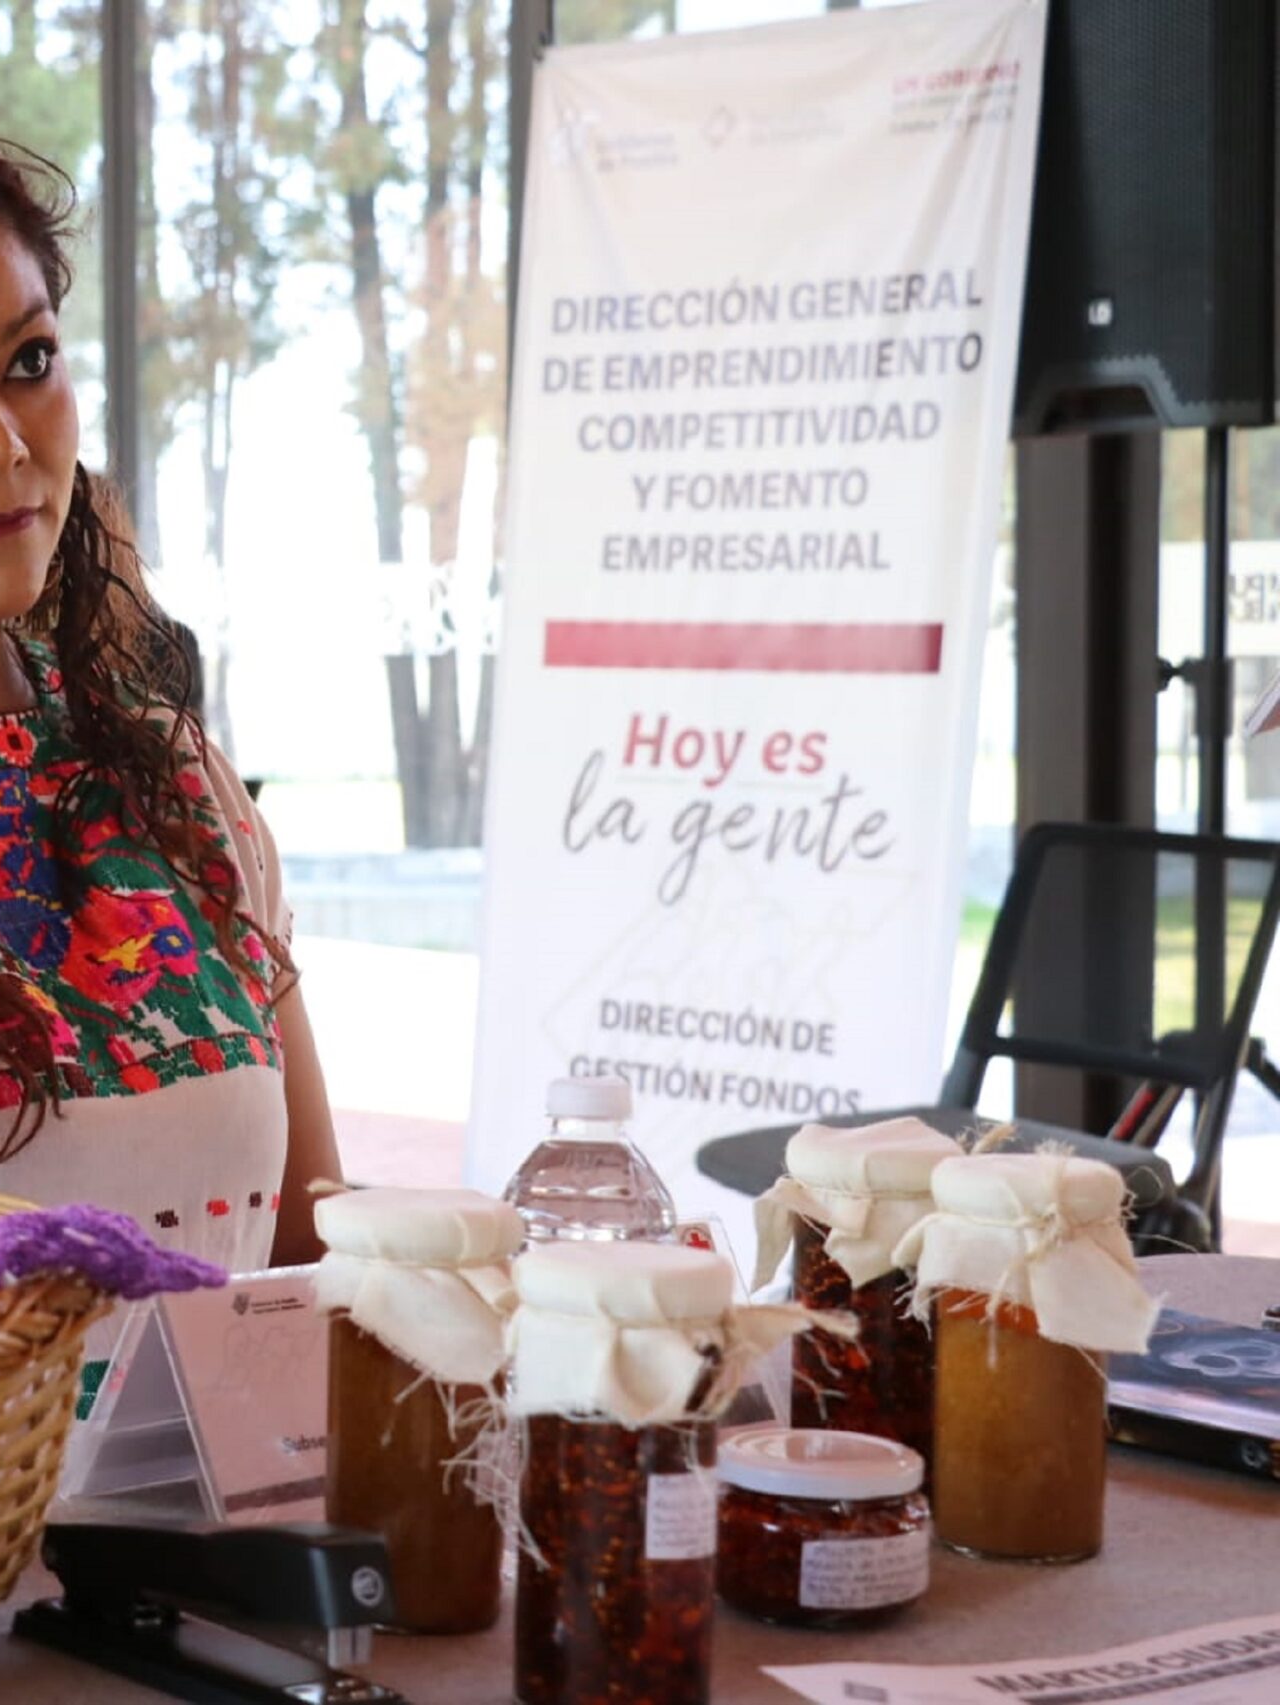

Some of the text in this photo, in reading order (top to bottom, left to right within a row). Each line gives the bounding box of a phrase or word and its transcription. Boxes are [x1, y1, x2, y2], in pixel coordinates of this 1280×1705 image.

[551, 269, 983, 335] DIRECCIÓN GENERAL
[542, 331, 983, 394] DE EMPRENDIMIENTO
[577, 401, 940, 452] COMPETITIVIDAD
[632, 468, 869, 512] Y FOMENTO
[601, 532, 890, 573] EMPRESARIAL
[623, 711, 829, 788] Hoy es
[562, 750, 898, 906] la gente
[599, 999, 837, 1056] DIRECCIÓN DE
[720, 1073, 862, 1115] FONDOS
[974, 1629, 1280, 1693] MARTES CIUDA
